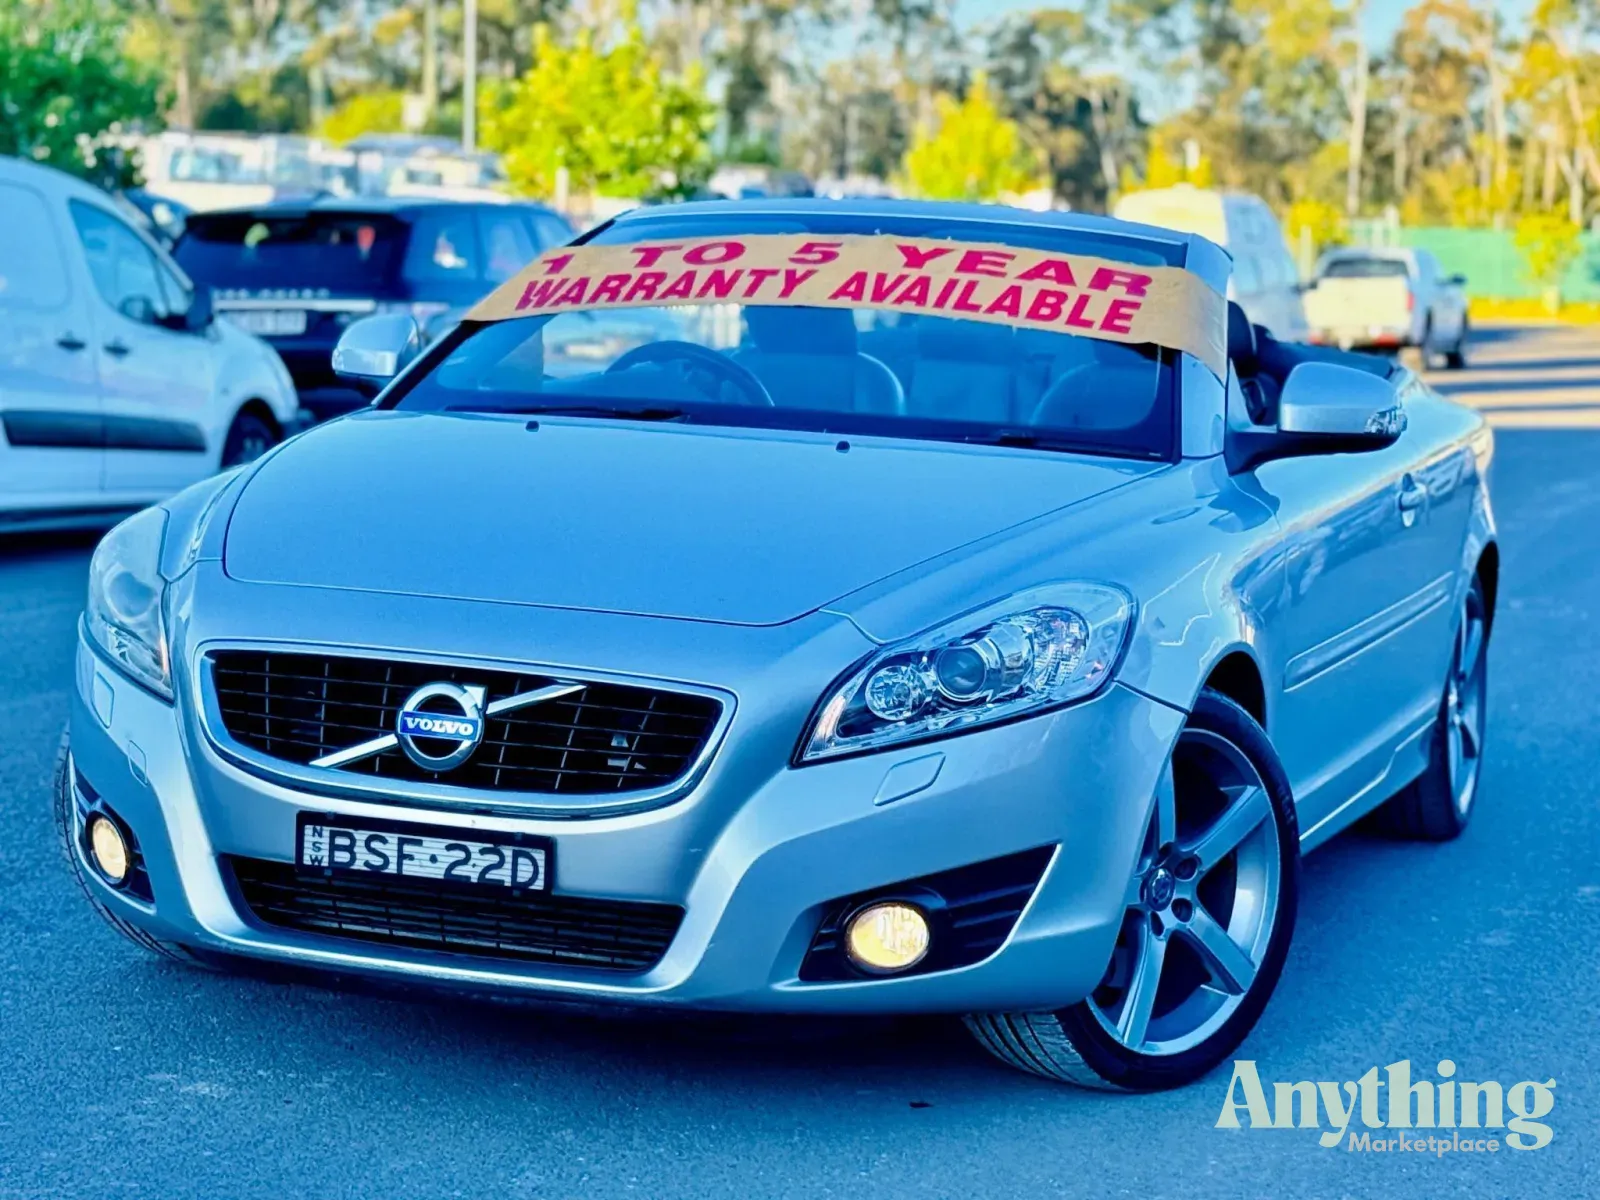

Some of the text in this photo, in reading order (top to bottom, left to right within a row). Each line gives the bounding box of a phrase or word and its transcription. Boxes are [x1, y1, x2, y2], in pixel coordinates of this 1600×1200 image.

[541, 241, 1153, 297] 1 TO 5 YEAR
[515, 268, 1142, 334] WARRANTY AVAILABLE
[403, 716, 474, 736] VOLVO
